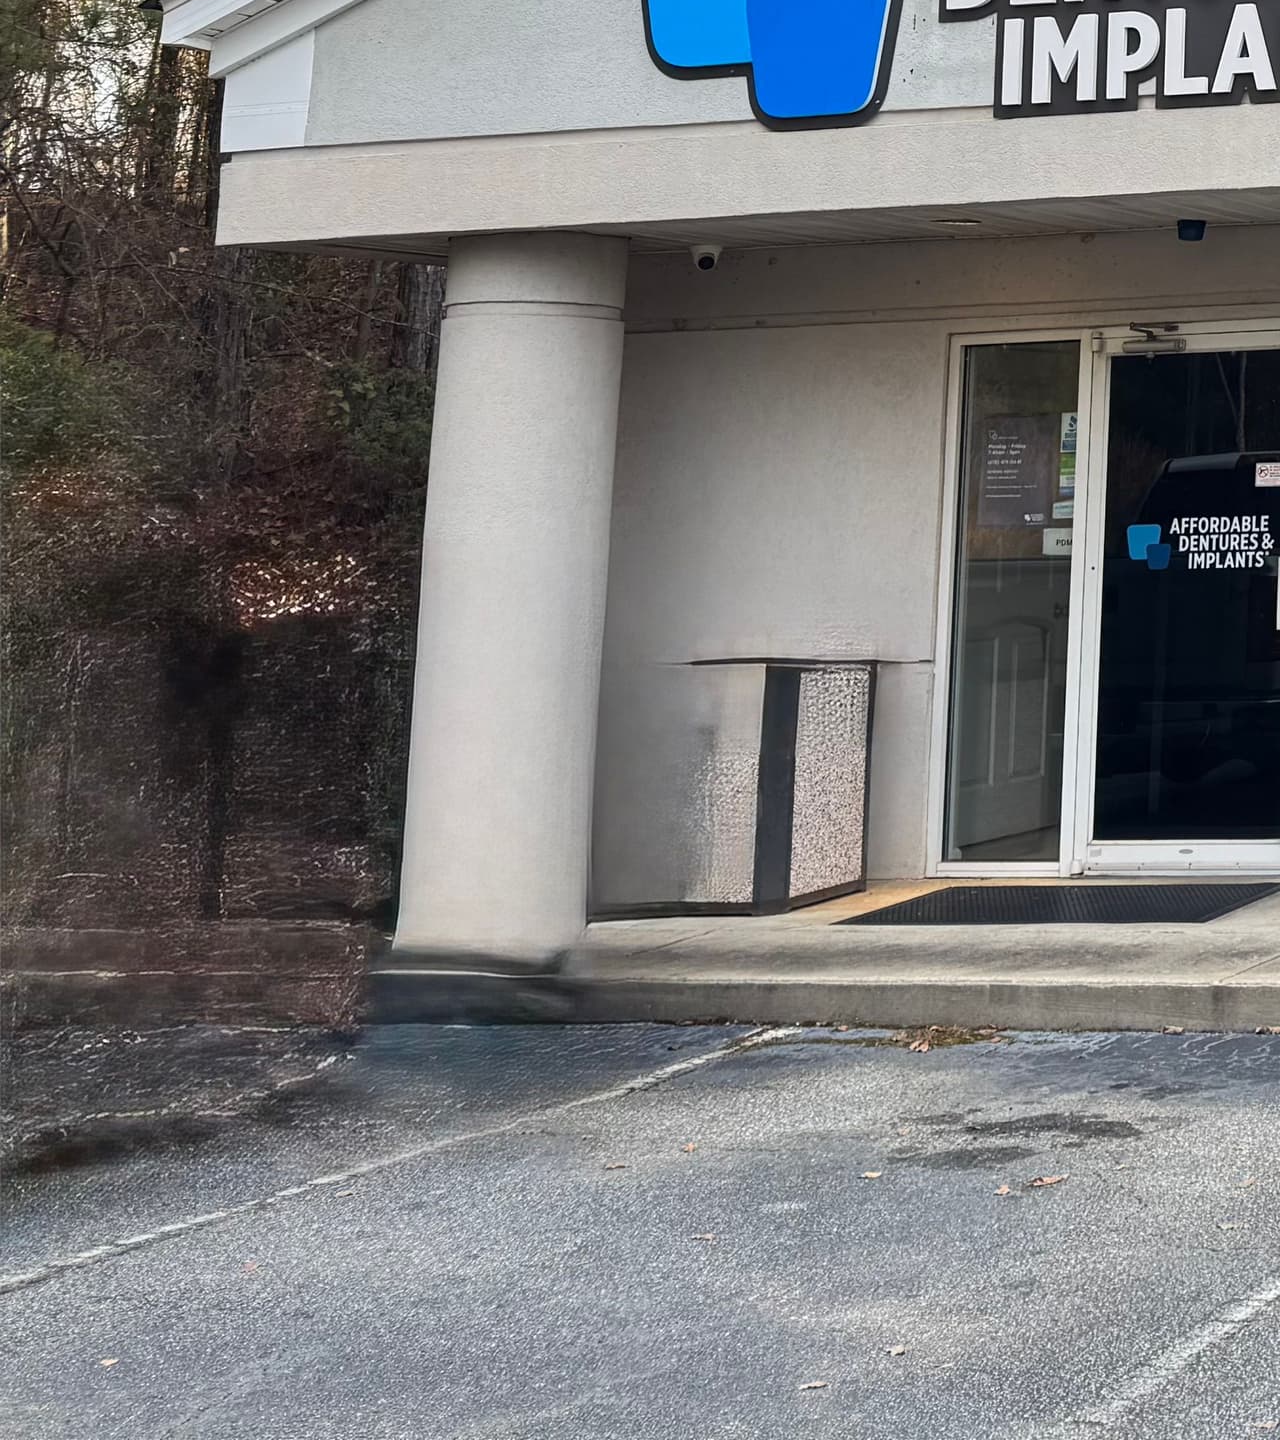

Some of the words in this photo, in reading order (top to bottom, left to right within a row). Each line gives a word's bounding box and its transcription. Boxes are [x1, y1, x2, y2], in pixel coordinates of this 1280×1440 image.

[1169, 515, 1270, 535] AFFORDABLE
[1178, 534, 1259, 553] DENTURES
[1261, 533, 1275, 550] &
